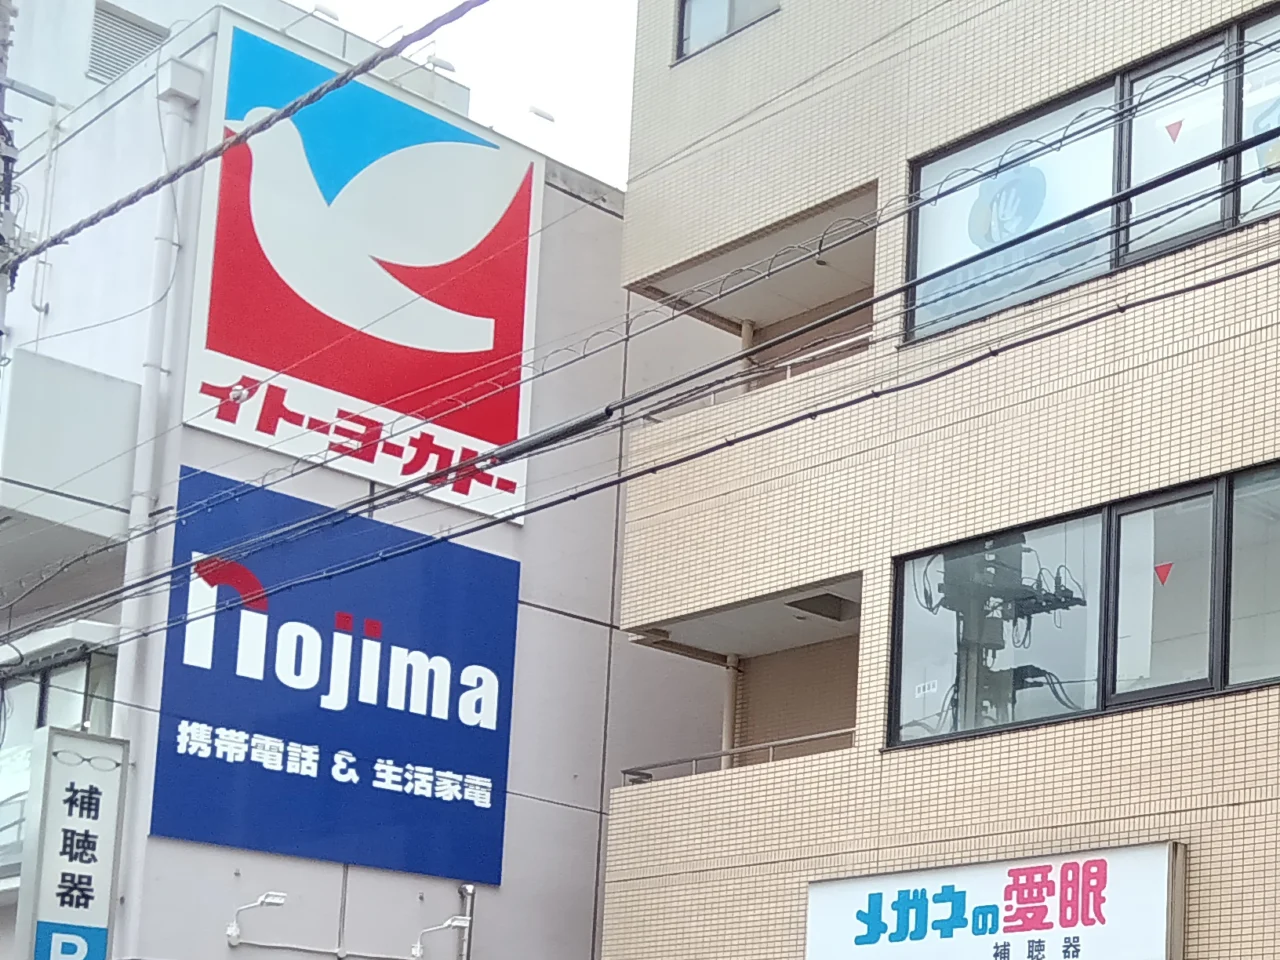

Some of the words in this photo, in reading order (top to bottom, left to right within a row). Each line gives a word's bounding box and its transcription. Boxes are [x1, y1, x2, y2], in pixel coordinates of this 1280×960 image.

[182, 551, 499, 731] nojima
[176, 719, 319, 778] 携帯電話
[372, 758, 493, 808] 生活家電
[55, 781, 103, 910] 補聴器
[854, 858, 1107, 946] メガネの愛眼
